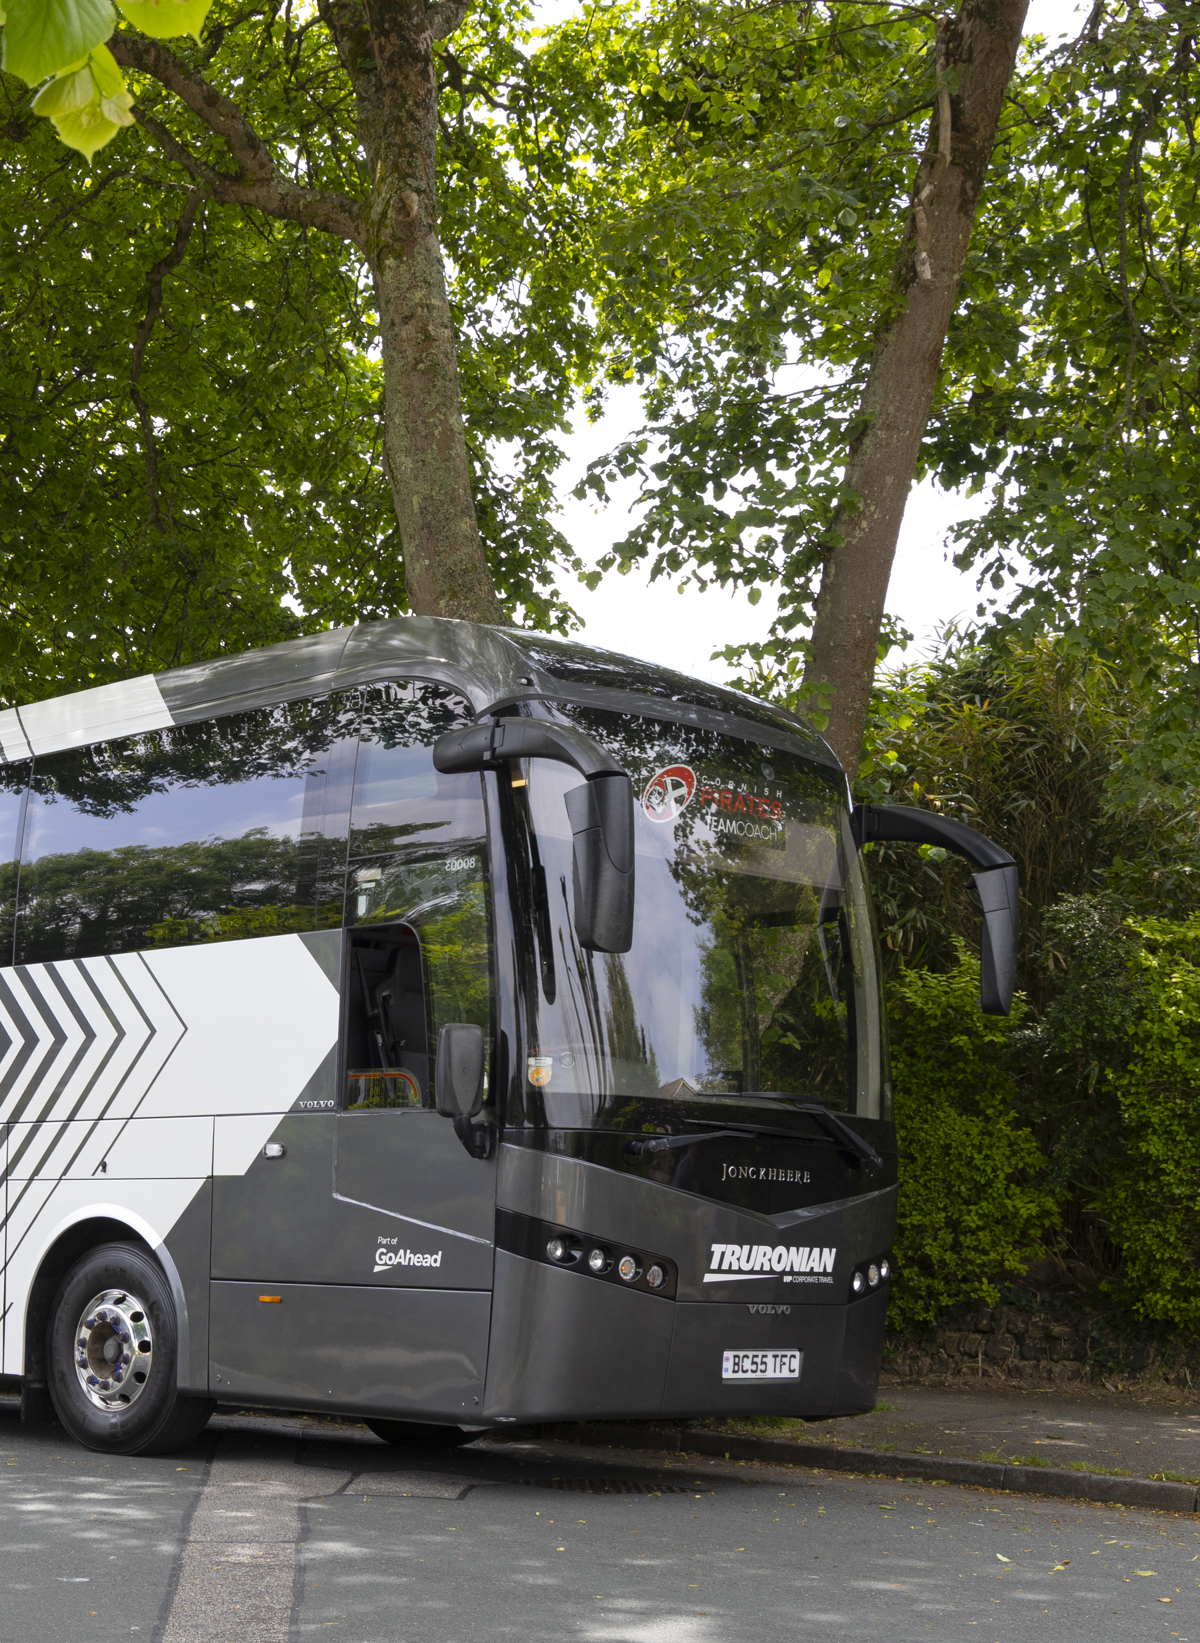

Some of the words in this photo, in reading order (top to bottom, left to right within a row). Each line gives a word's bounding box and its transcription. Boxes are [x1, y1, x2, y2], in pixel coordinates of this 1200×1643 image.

[701, 775, 783, 798] CORNISH
[701, 786, 782, 820] PIRATES
[298, 1099, 335, 1109] VOLVO
[721, 1163, 811, 1185] JONCKHEERE
[377, 1235, 391, 1245] Part
[390, 1237, 399, 1246] of
[375, 1247, 443, 1268] GoAhead
[709, 1243, 837, 1273] TRURONIAN
[783, 1275, 793, 1283] VIP
[792, 1275, 818, 1283] CORPORATE
[818, 1276, 834, 1284] TRAVEL
[746, 1304, 792, 1315] VOLVO
[731, 1354, 768, 1374] BC55
[771, 1354, 797, 1374] TFC
